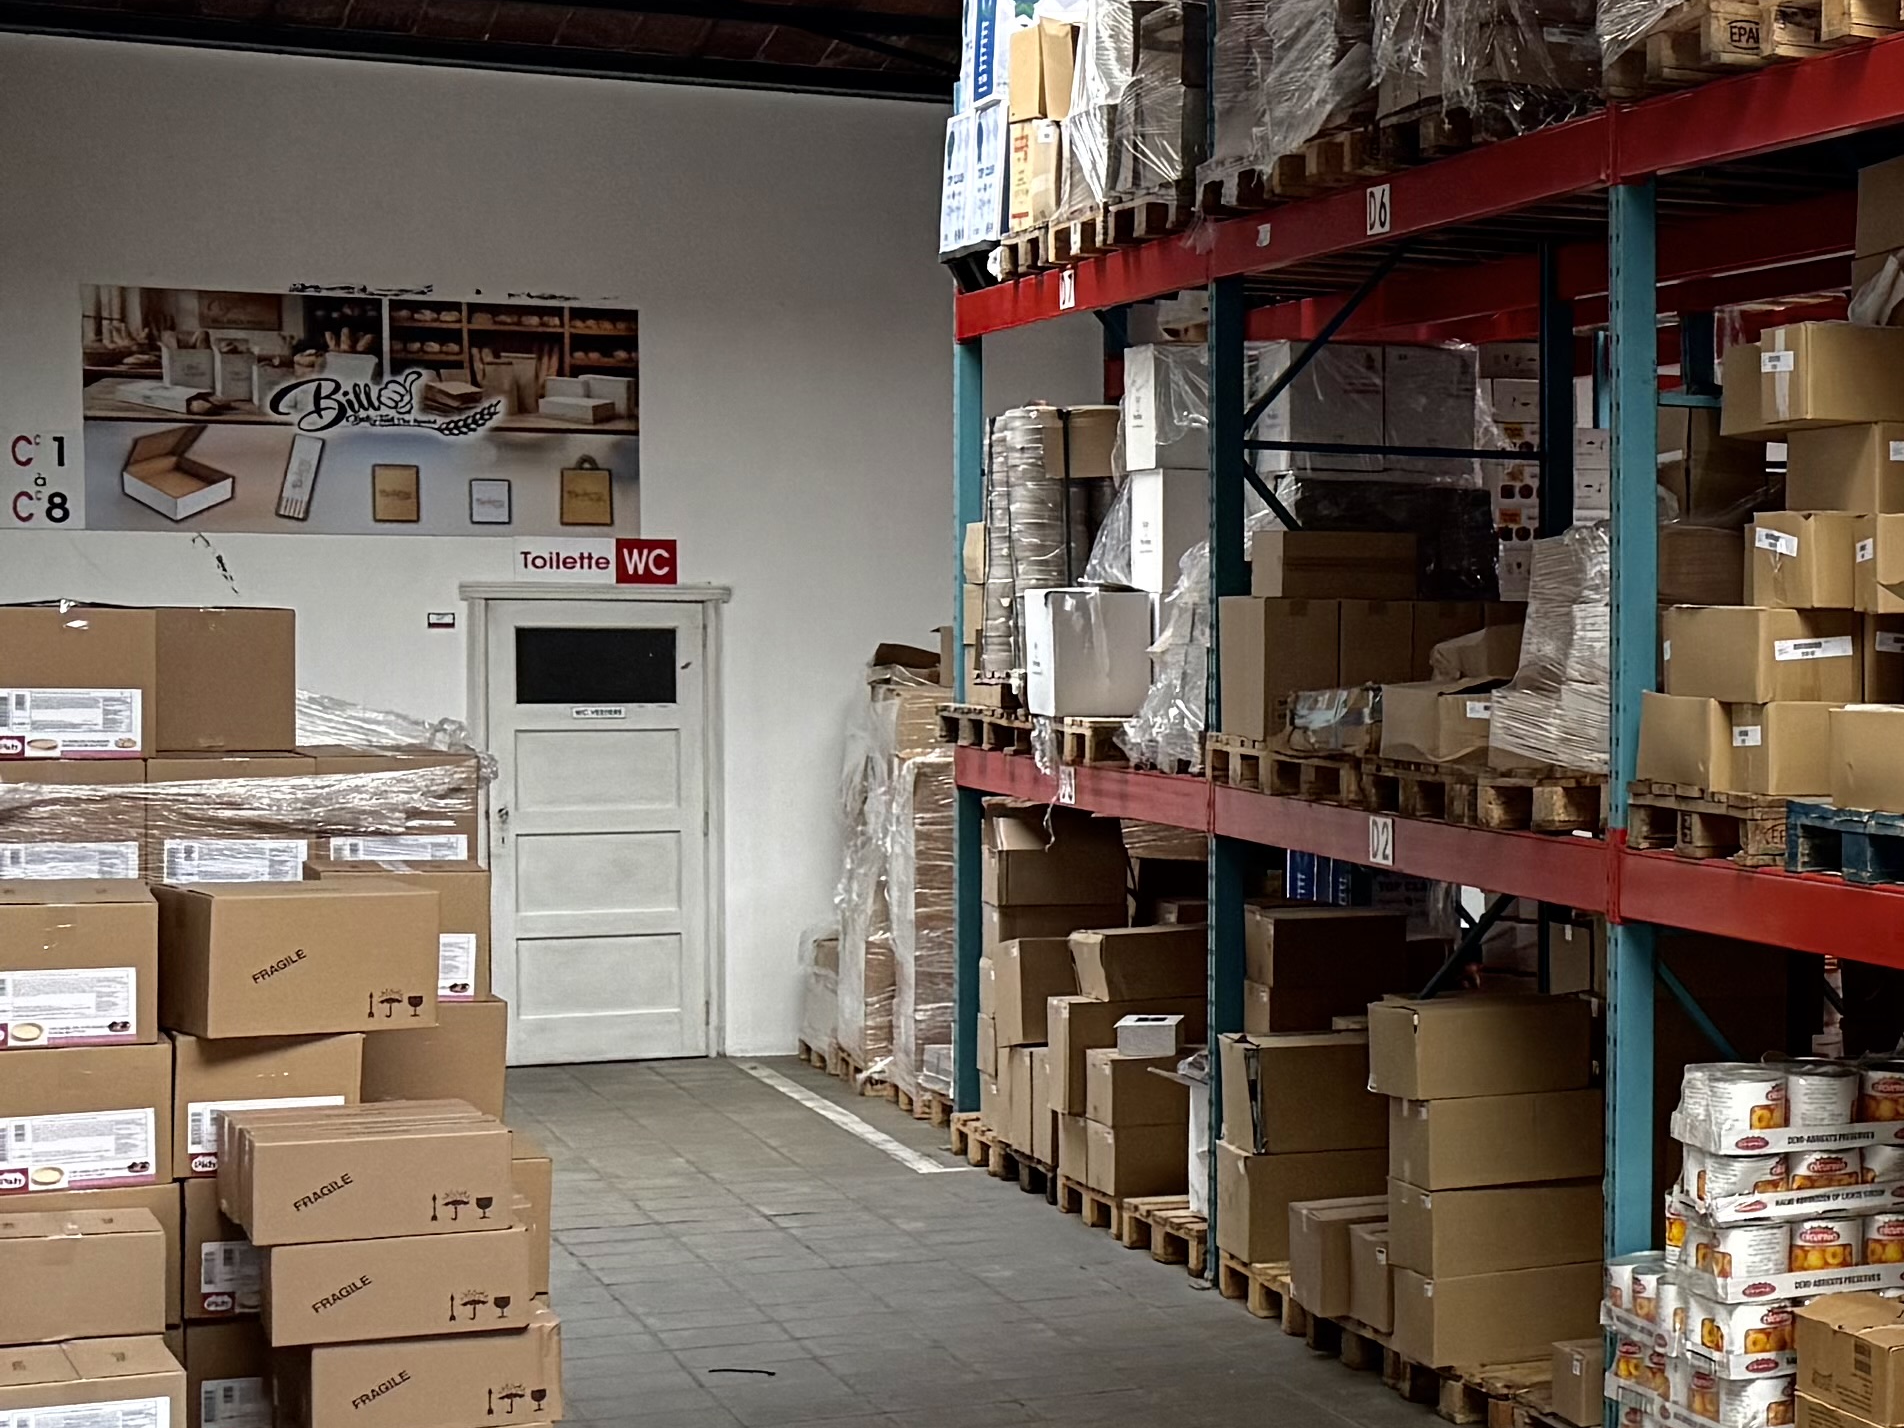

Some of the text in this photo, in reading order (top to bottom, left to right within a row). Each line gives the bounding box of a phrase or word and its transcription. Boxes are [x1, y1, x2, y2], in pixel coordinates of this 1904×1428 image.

[520, 548, 671, 576] Toilette WC
[251, 948, 308, 984] FRAGILE
[293, 1173, 354, 1212] FRAGILE
[312, 1274, 373, 1314] FRAGILE
[352, 1370, 411, 1410] FRAGILE
